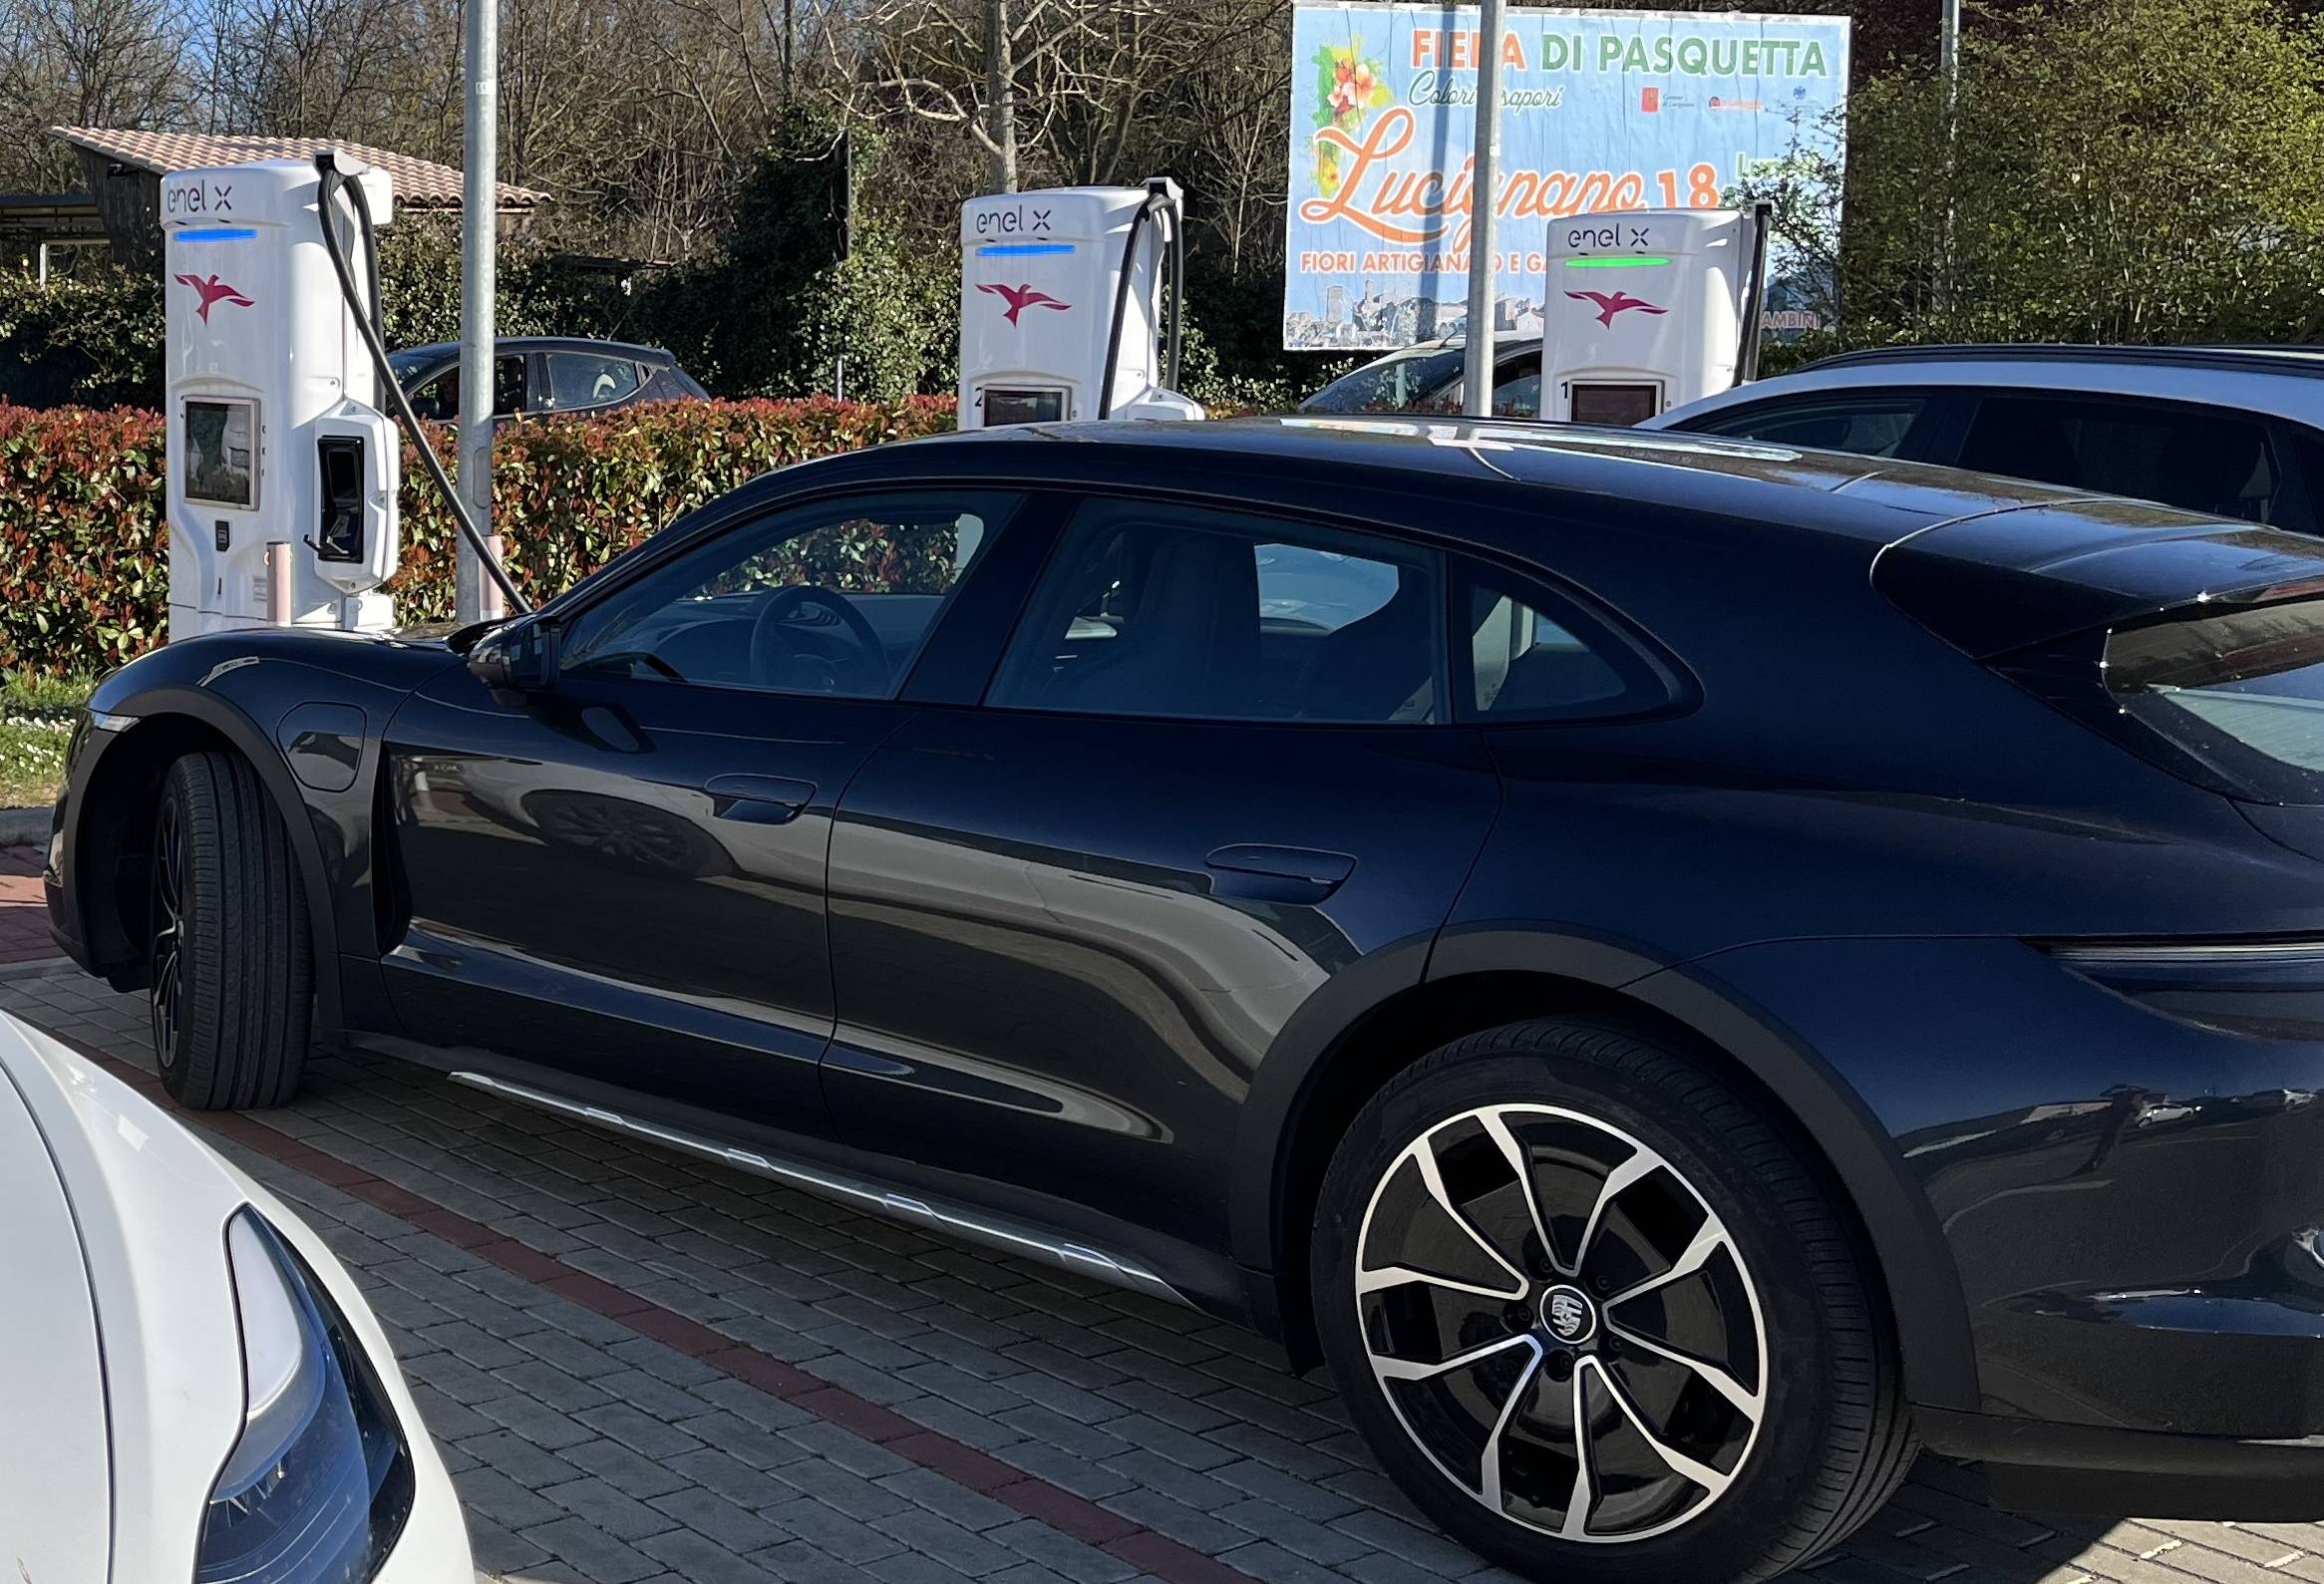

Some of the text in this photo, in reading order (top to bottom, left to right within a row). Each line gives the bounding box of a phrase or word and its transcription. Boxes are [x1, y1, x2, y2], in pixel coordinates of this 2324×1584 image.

[1541, 34, 1581, 71] DI
[1599, 36, 1826, 77] PASQUETTA
[1410, 70, 1564, 115] Colori sapori
[167, 179, 205, 213] enel
[1657, 163, 1718, 208] 18
[976, 204, 1024, 234] enel
[1568, 223, 1620, 248] enel
[1300, 252, 1355, 272] FIORI
[1362, 252, 1502, 273] ARTIGIAN
[1509, 253, 1519, 272] E
[1760, 311, 1821, 330] AMBINI
[1561, 381, 1568, 400] 1
